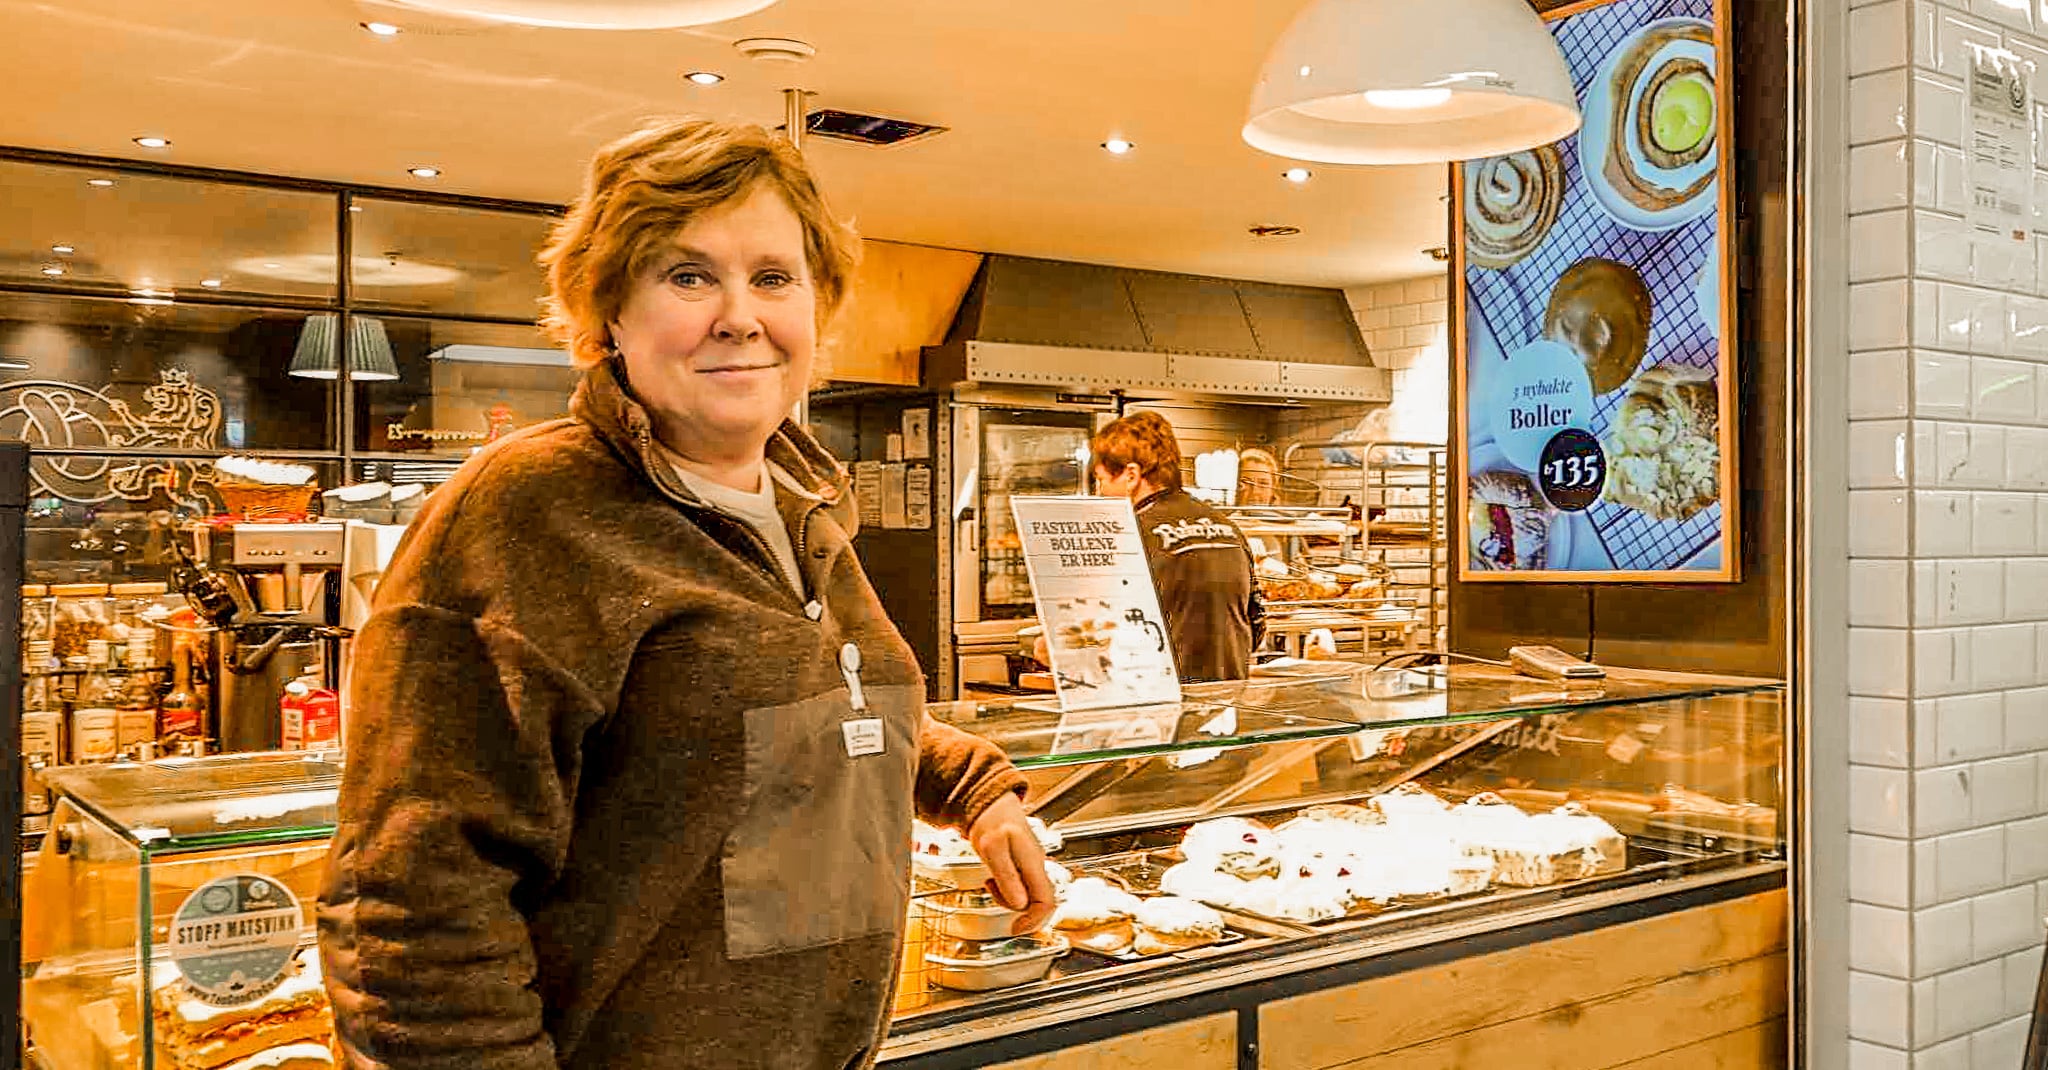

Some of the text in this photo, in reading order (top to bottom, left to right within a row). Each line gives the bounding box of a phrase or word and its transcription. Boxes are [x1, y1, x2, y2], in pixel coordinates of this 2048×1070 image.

[1523, 375, 1574, 400] nybakte
[1510, 404, 1571, 429] Boller
[1049, 537, 1118, 551] BOLLENE
[1060, 553, 1116, 567] ER HER!
[178, 923, 221, 944] STOPP
[226, 915, 295, 938] MATSVINN
